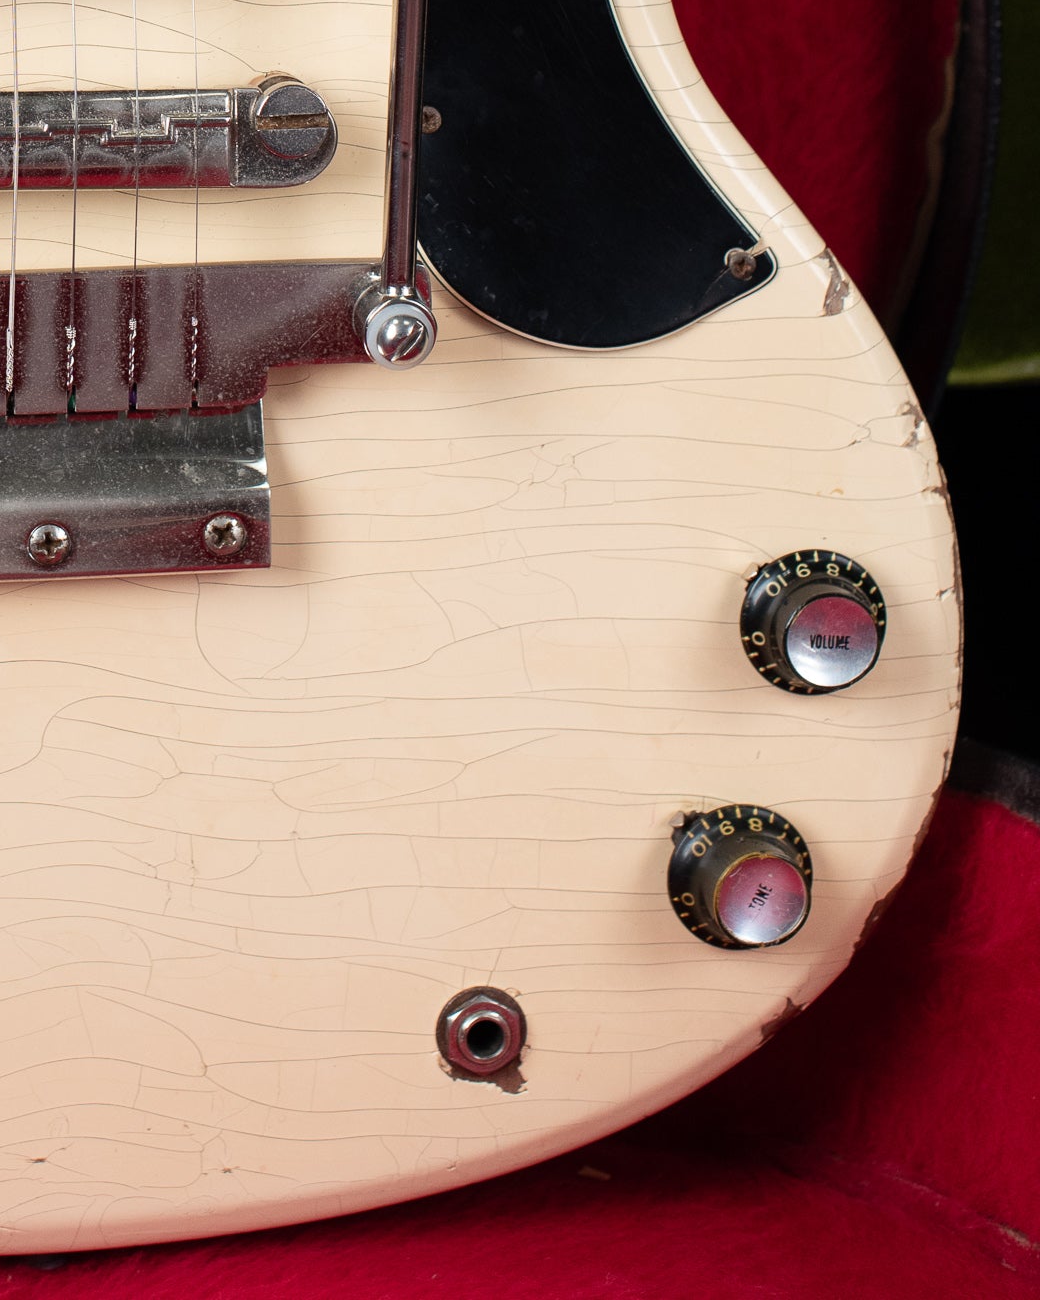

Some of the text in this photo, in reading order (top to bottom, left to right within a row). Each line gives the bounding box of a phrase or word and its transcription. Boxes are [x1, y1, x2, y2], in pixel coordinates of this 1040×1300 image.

[826, 563, 840, 577] 8
[810, 634, 851, 650] VOLUME
[748, 818, 763, 832] 8
[748, 883, 773, 910] TONE
